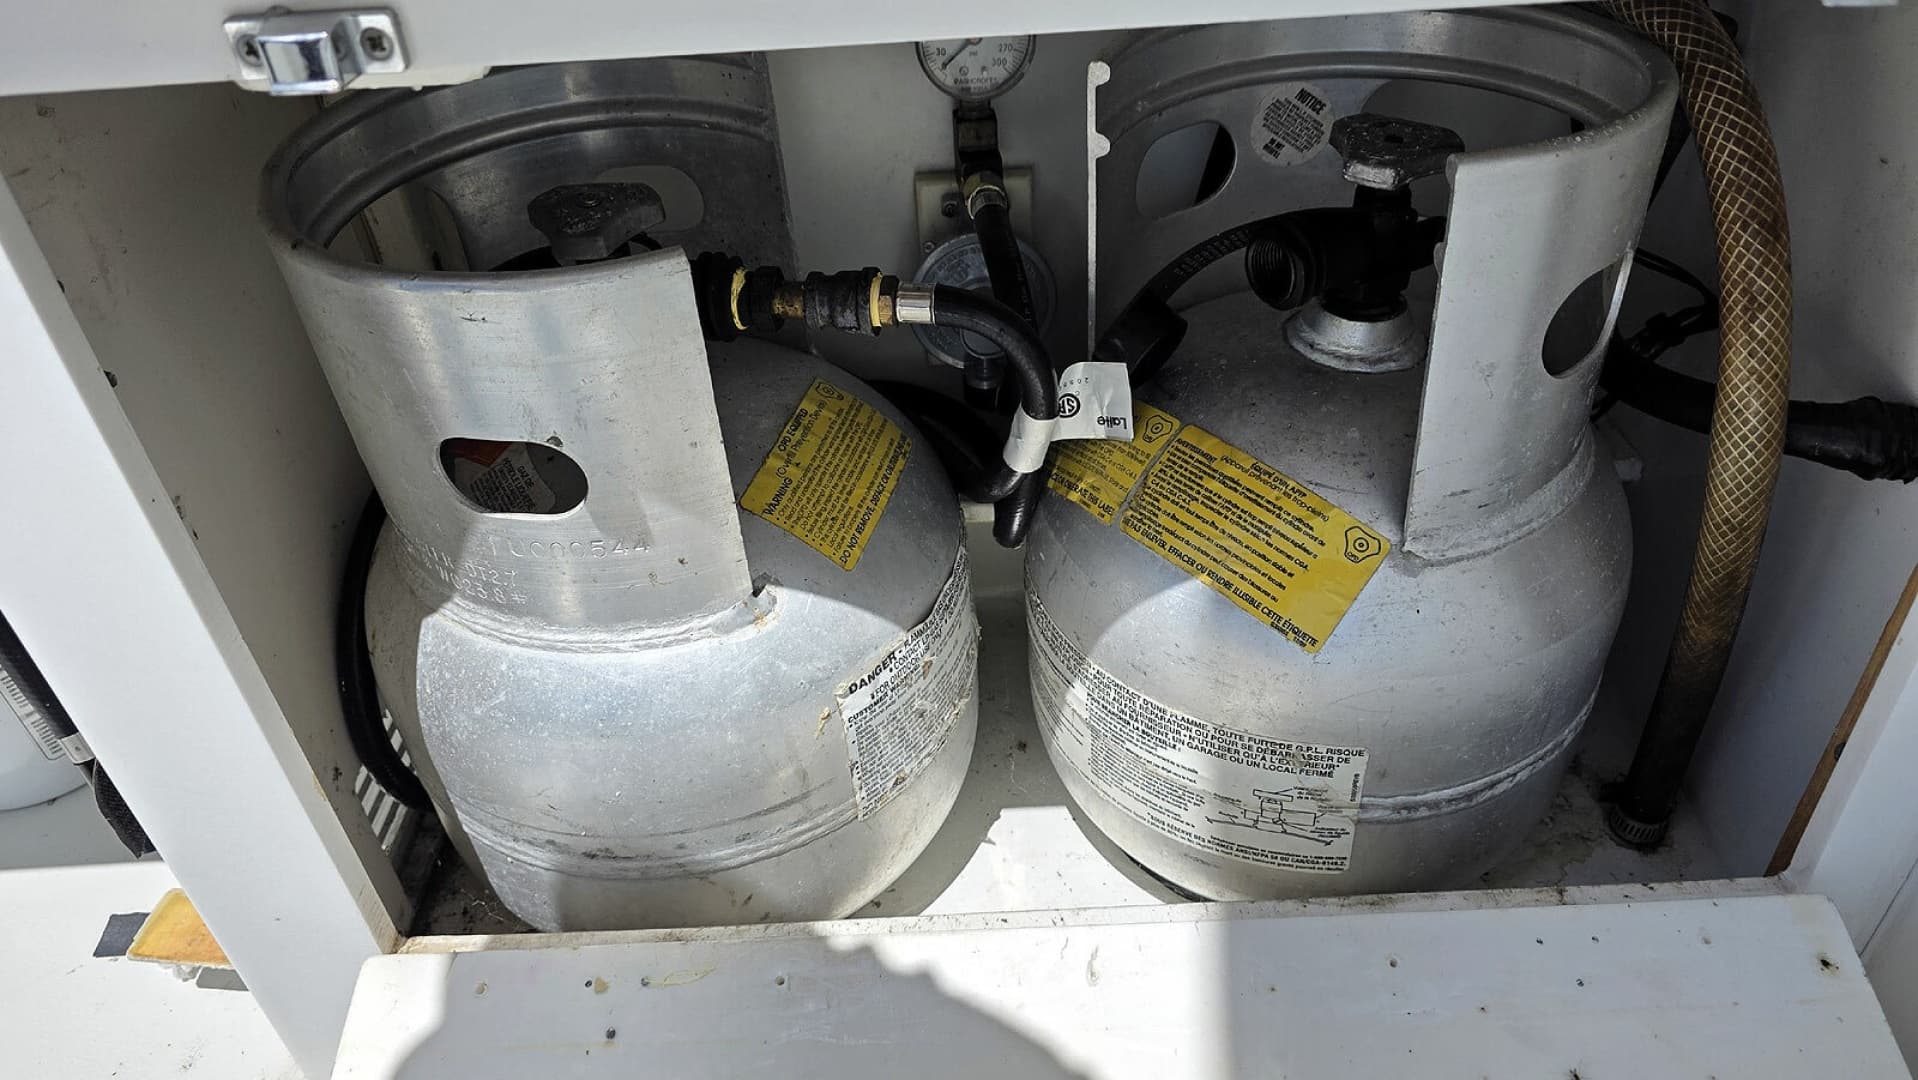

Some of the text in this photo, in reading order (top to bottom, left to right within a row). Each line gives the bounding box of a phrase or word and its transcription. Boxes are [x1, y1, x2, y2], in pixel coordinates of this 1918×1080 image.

[1293, 86, 1327, 115] NOTICE
[786, 406, 809, 438] EQUIPPED
[763, 474, 793, 518] WARNING
[838, 549, 851, 563] DO
[845, 533, 859, 550] NOT
[1166, 544, 1197, 567] EFFACER
[1194, 561, 1208, 574] OU
[1205, 568, 1235, 591] RENDRE
[1230, 586, 1263, 611] ILLISIBLE
[1260, 605, 1284, 624] CETTE
[1280, 616, 1321, 647] ÉTIQUETTE
[846, 650, 900, 695] DANGER
[844, 691, 891, 723] CUSTOMER
[1104, 675, 1142, 702] CONTACT
[1211, 725, 1246, 742] TOUTE
[1278, 742, 1292, 750] DE
[1325, 747, 1366, 758] RISQUE
[1184, 740, 1228, 760] GARAGE
[1228, 754, 1244, 764] OU
[1245, 758, 1260, 769] UN
[1262, 762, 1297, 774] LOCAL
[1298, 766, 1334, 779] FERMÉ
[1186, 734, 1241, 756] N'UTILISER
[1193, 728, 1209, 739] OU
[1210, 733, 1239, 748] POUR
[1240, 742, 1254, 752] SE
[1336, 756, 1350, 764] DE
